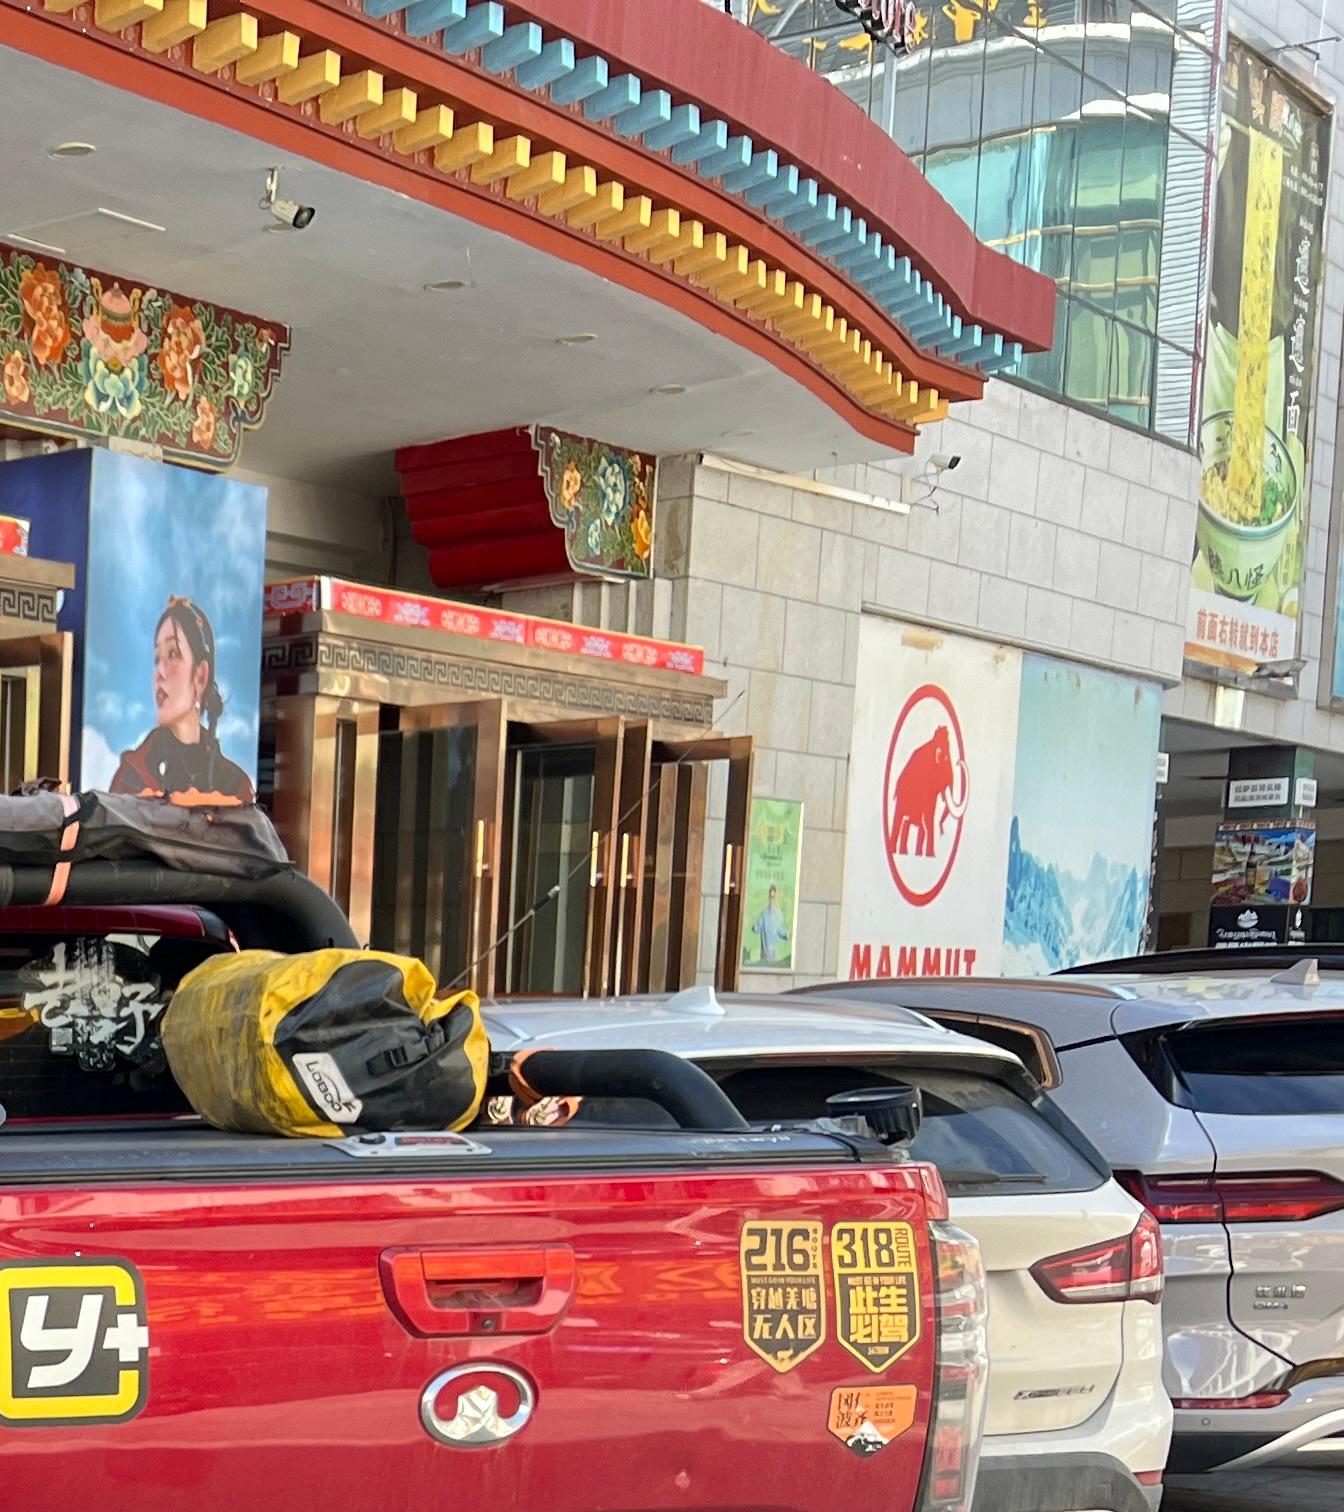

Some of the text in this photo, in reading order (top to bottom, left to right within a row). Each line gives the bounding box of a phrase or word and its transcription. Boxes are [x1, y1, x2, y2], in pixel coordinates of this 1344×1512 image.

[1196, 609, 1281, 658] 前面右转就到本店
[849, 943, 977, 980] MAMMUT
[744, 1228, 810, 1272] 216
[837, 1228, 896, 1269] 318
[895, 1228, 912, 1268] ROUTE
[849, 1285, 909, 1313] 此生
[753, 1313, 817, 1340] 无人区
